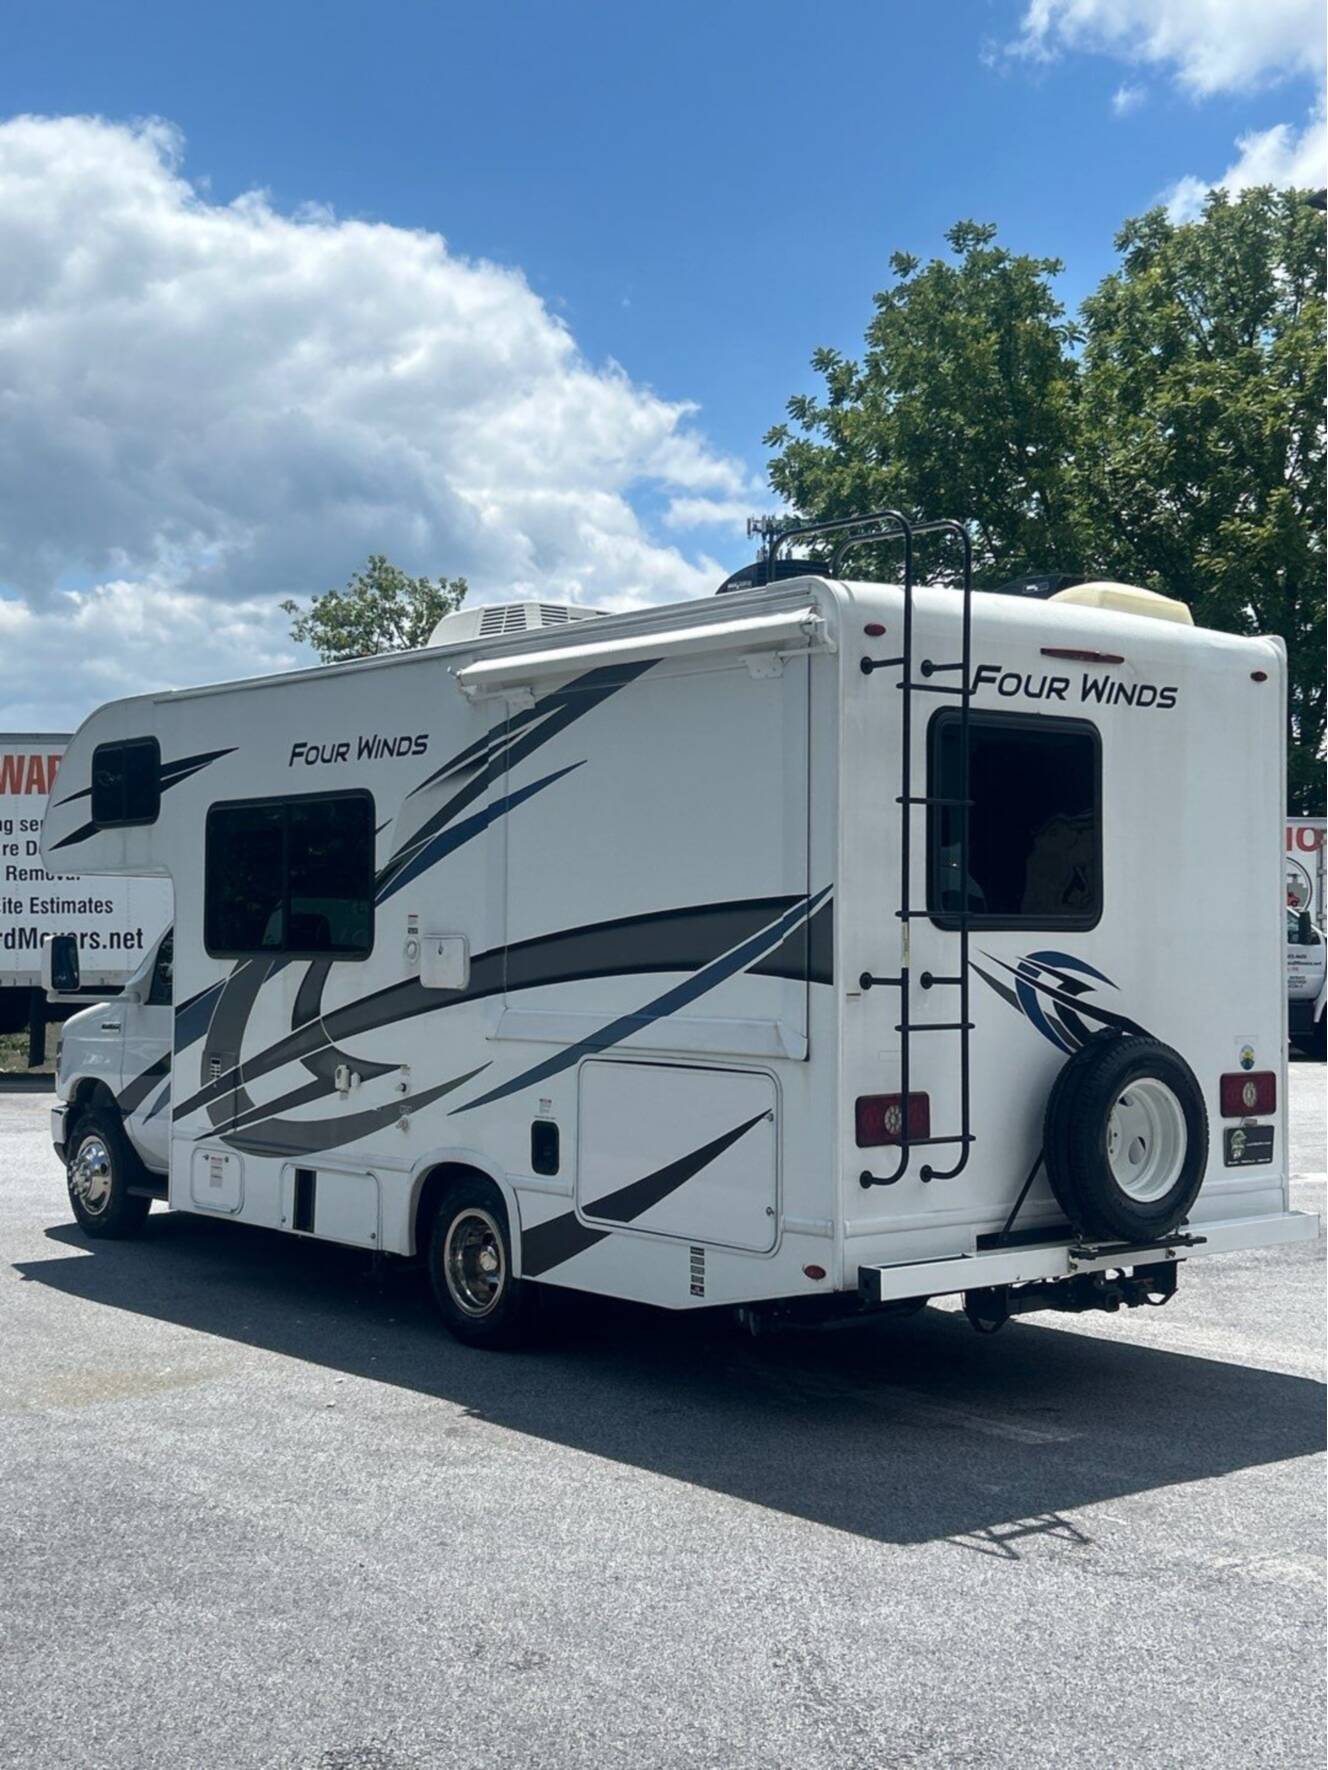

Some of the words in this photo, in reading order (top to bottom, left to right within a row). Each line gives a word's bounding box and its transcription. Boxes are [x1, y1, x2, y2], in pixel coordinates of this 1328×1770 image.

[970, 664, 1070, 701] FOUR
[1080, 673, 1178, 709] WINDS
[289, 742, 351, 767] FOUR
[357, 734, 429, 760] WINDS
[0, 819, 13, 836] g
[26, 840, 41, 856] D
[0, 897, 23, 914] ite
[30, 897, 113, 914] Estimates
